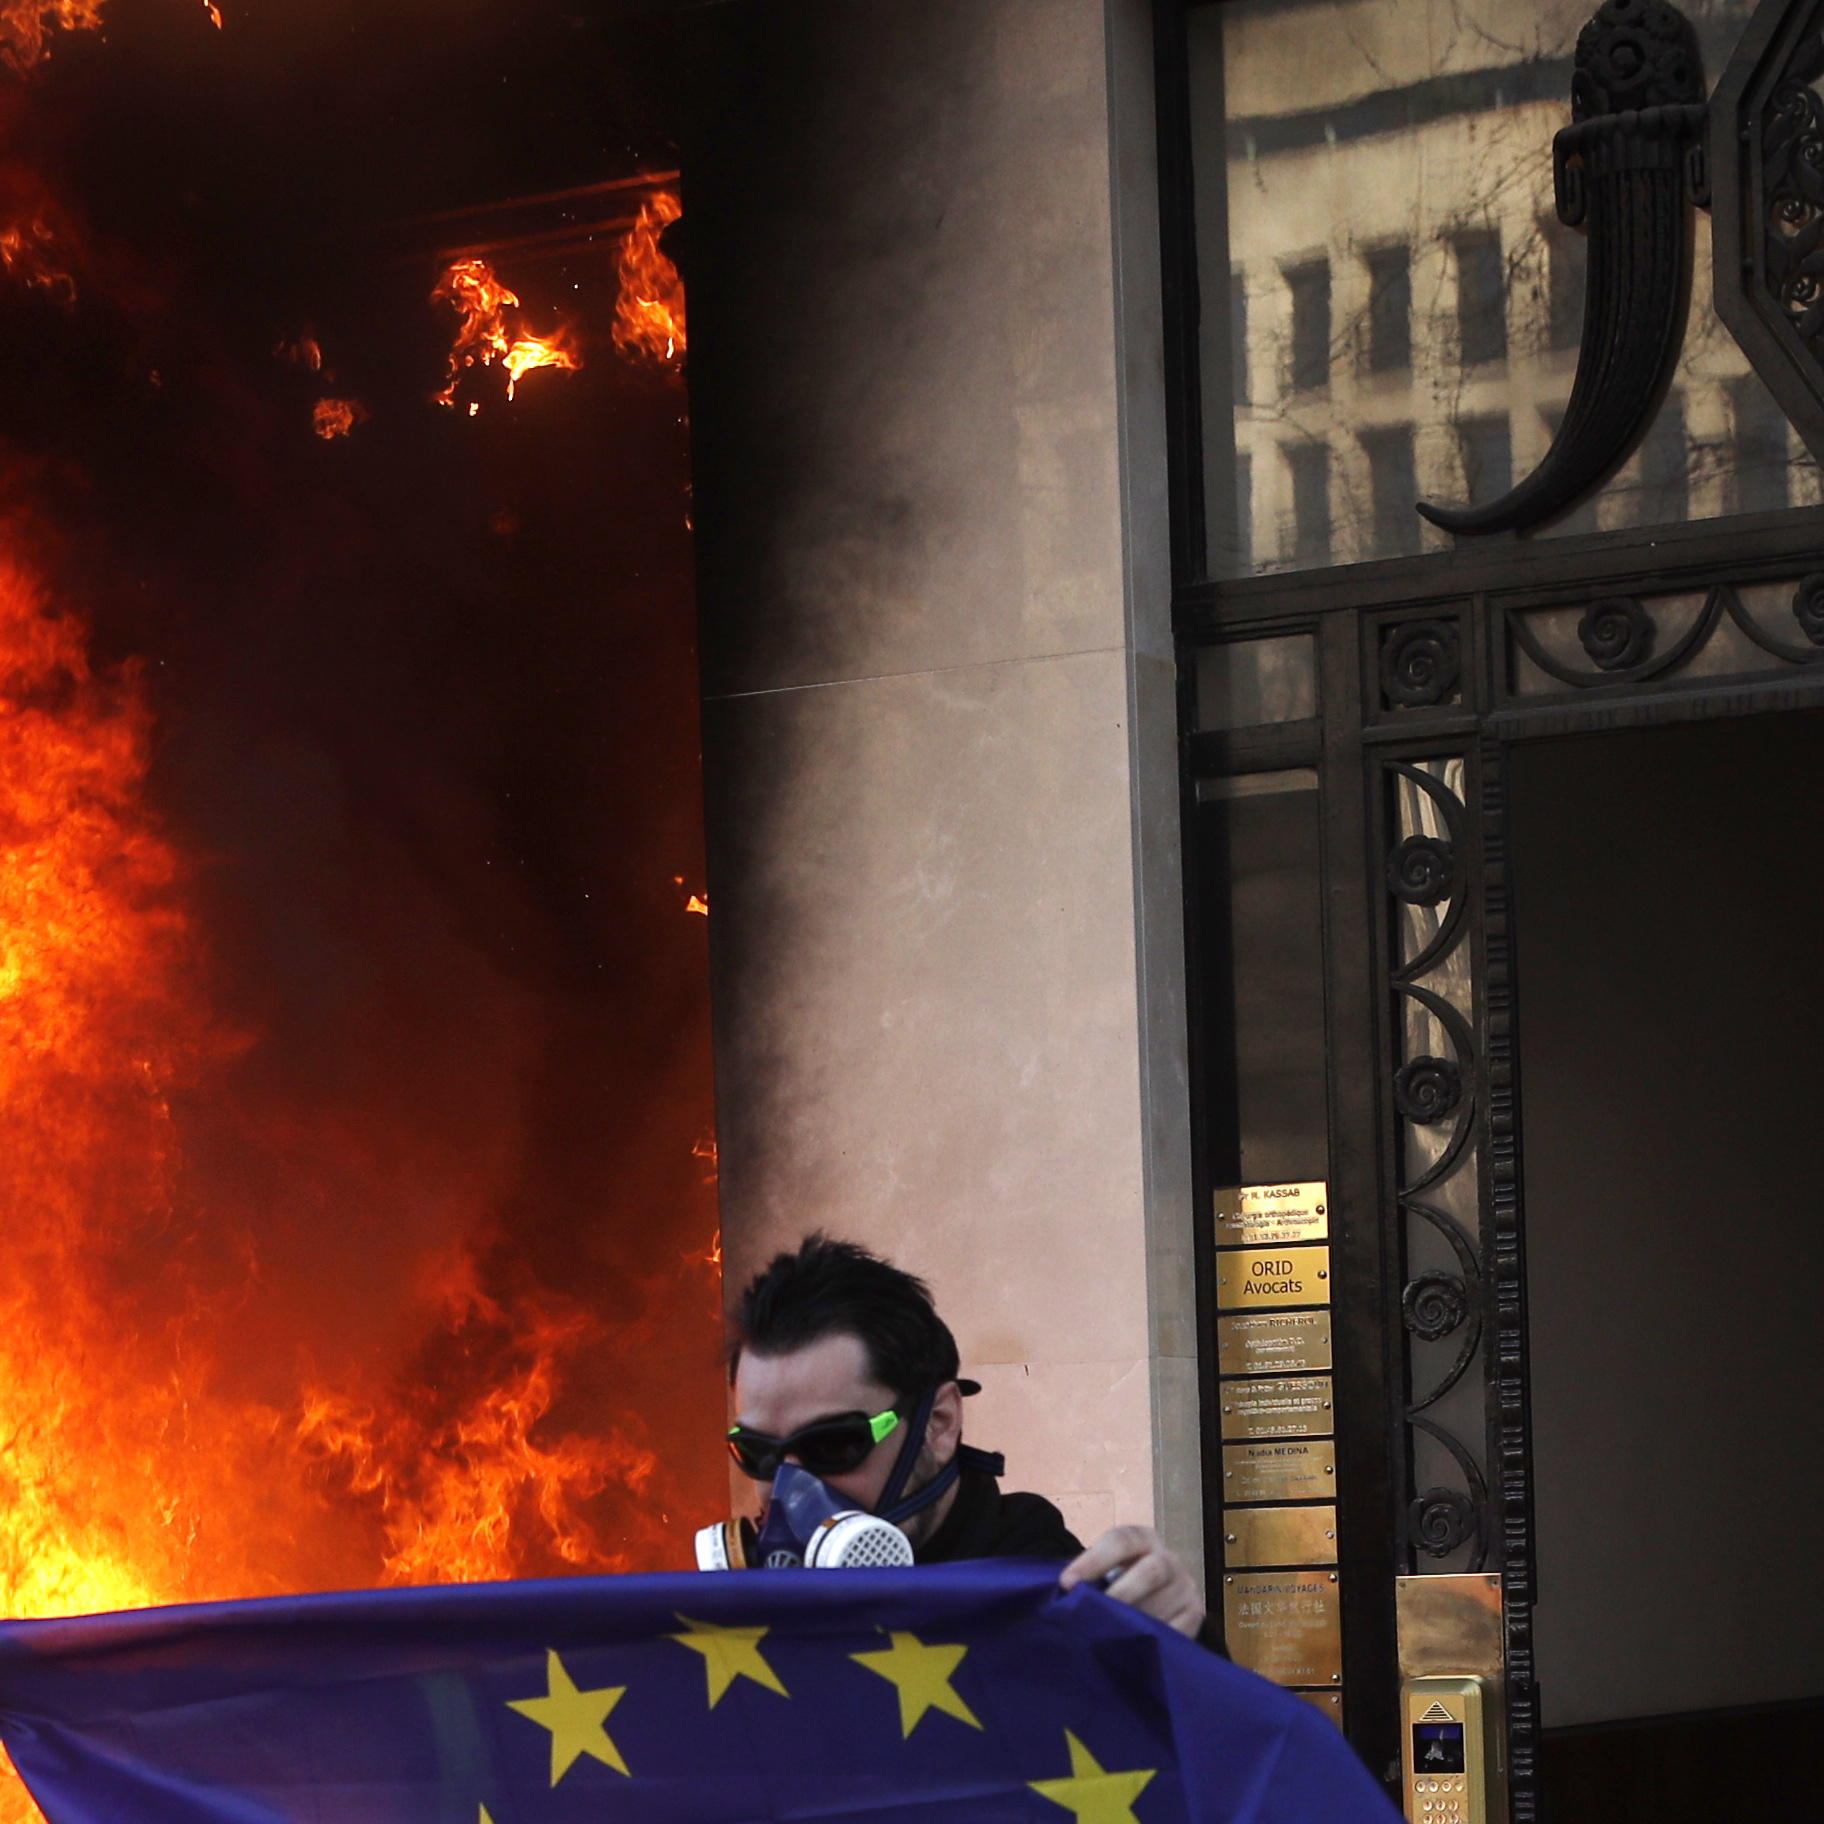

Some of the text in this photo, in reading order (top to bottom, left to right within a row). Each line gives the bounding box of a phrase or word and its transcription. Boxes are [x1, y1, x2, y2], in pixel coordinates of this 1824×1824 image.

[1263, 1188, 1300, 1199] KASSAB
[1251, 1260, 1293, 1276] ORID
[1243, 1279, 1303, 1295] Avocats
[1274, 1447, 1309, 1456] MEDINA
